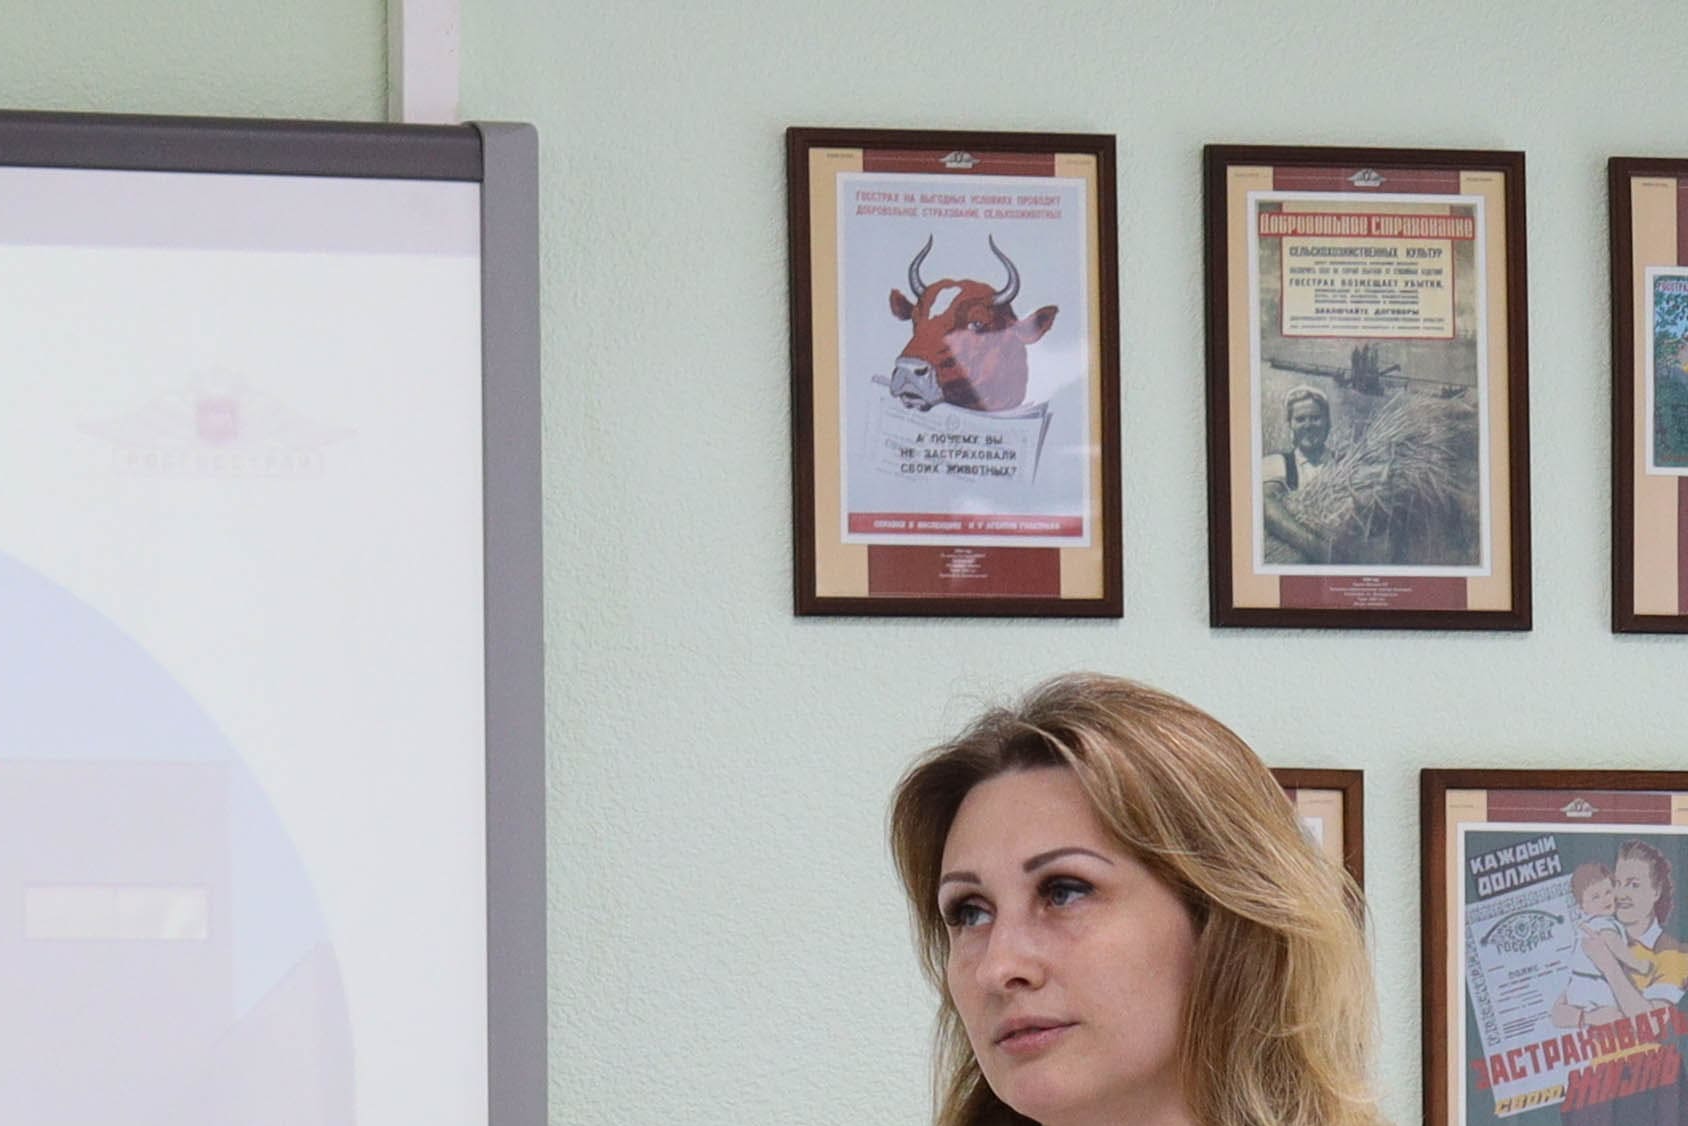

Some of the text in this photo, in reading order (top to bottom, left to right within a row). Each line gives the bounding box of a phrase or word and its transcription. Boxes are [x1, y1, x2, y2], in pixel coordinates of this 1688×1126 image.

[931, 433, 979, 445] ПОЧЕМУ
[924, 447, 1017, 461] ЗАСТРАХОВАЛИ
[900, 462, 939, 474] СВОИХ
[1477, 853, 1563, 897] ДОЛЖЕН
